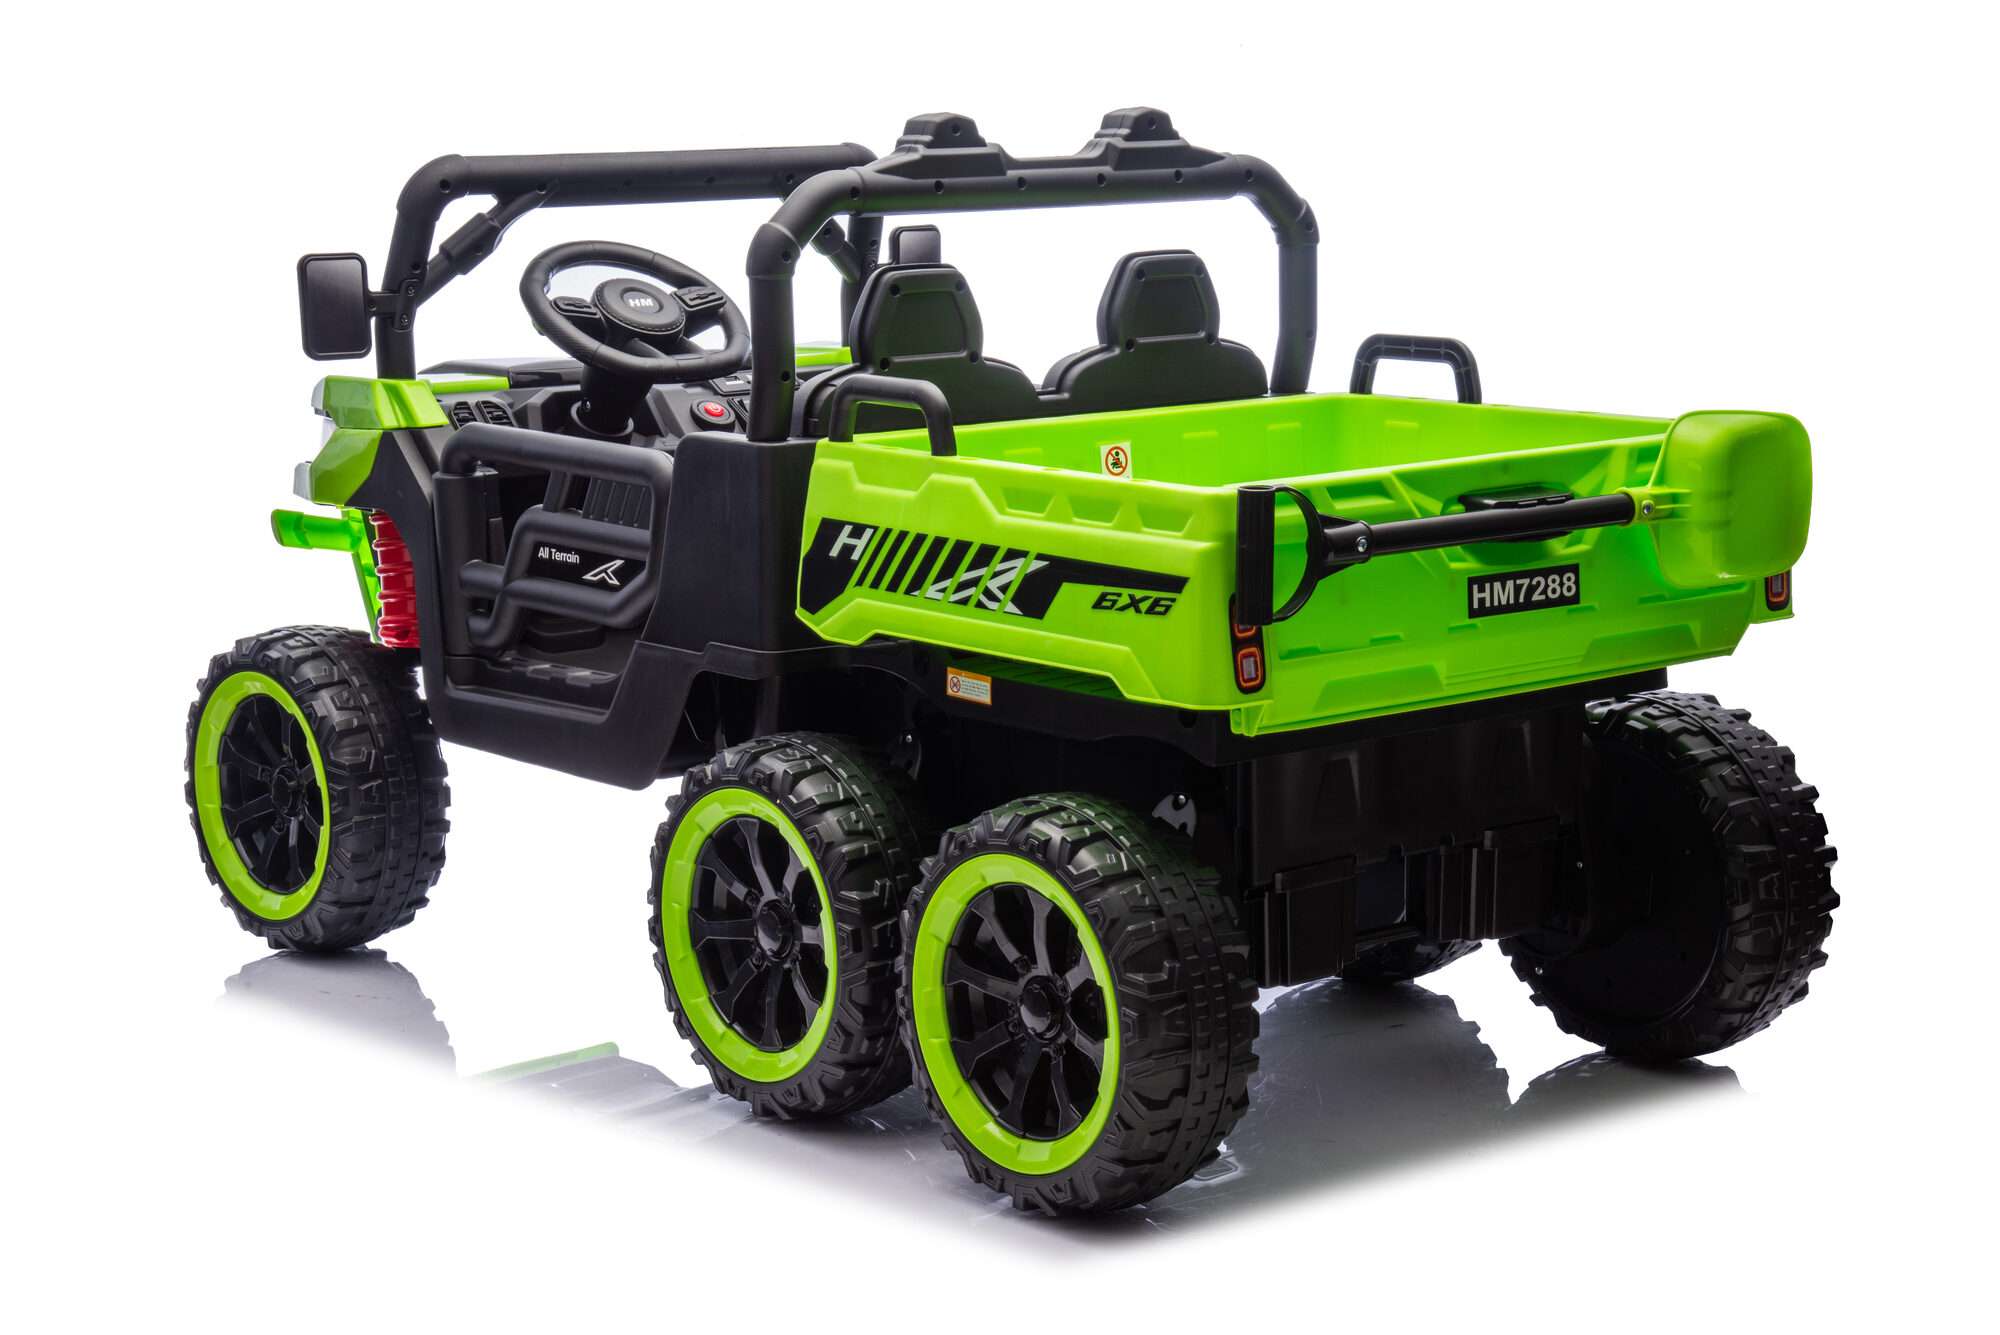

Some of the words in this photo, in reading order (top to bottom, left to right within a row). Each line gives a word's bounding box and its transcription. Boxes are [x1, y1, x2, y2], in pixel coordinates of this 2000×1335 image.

[629, 298, 654, 307] HM
[537, 546, 549, 558] All
[550, 548, 580, 564] Terrain
[1472, 572, 1577, 609] HM7288
[1090, 591, 1177, 616] 6X6
